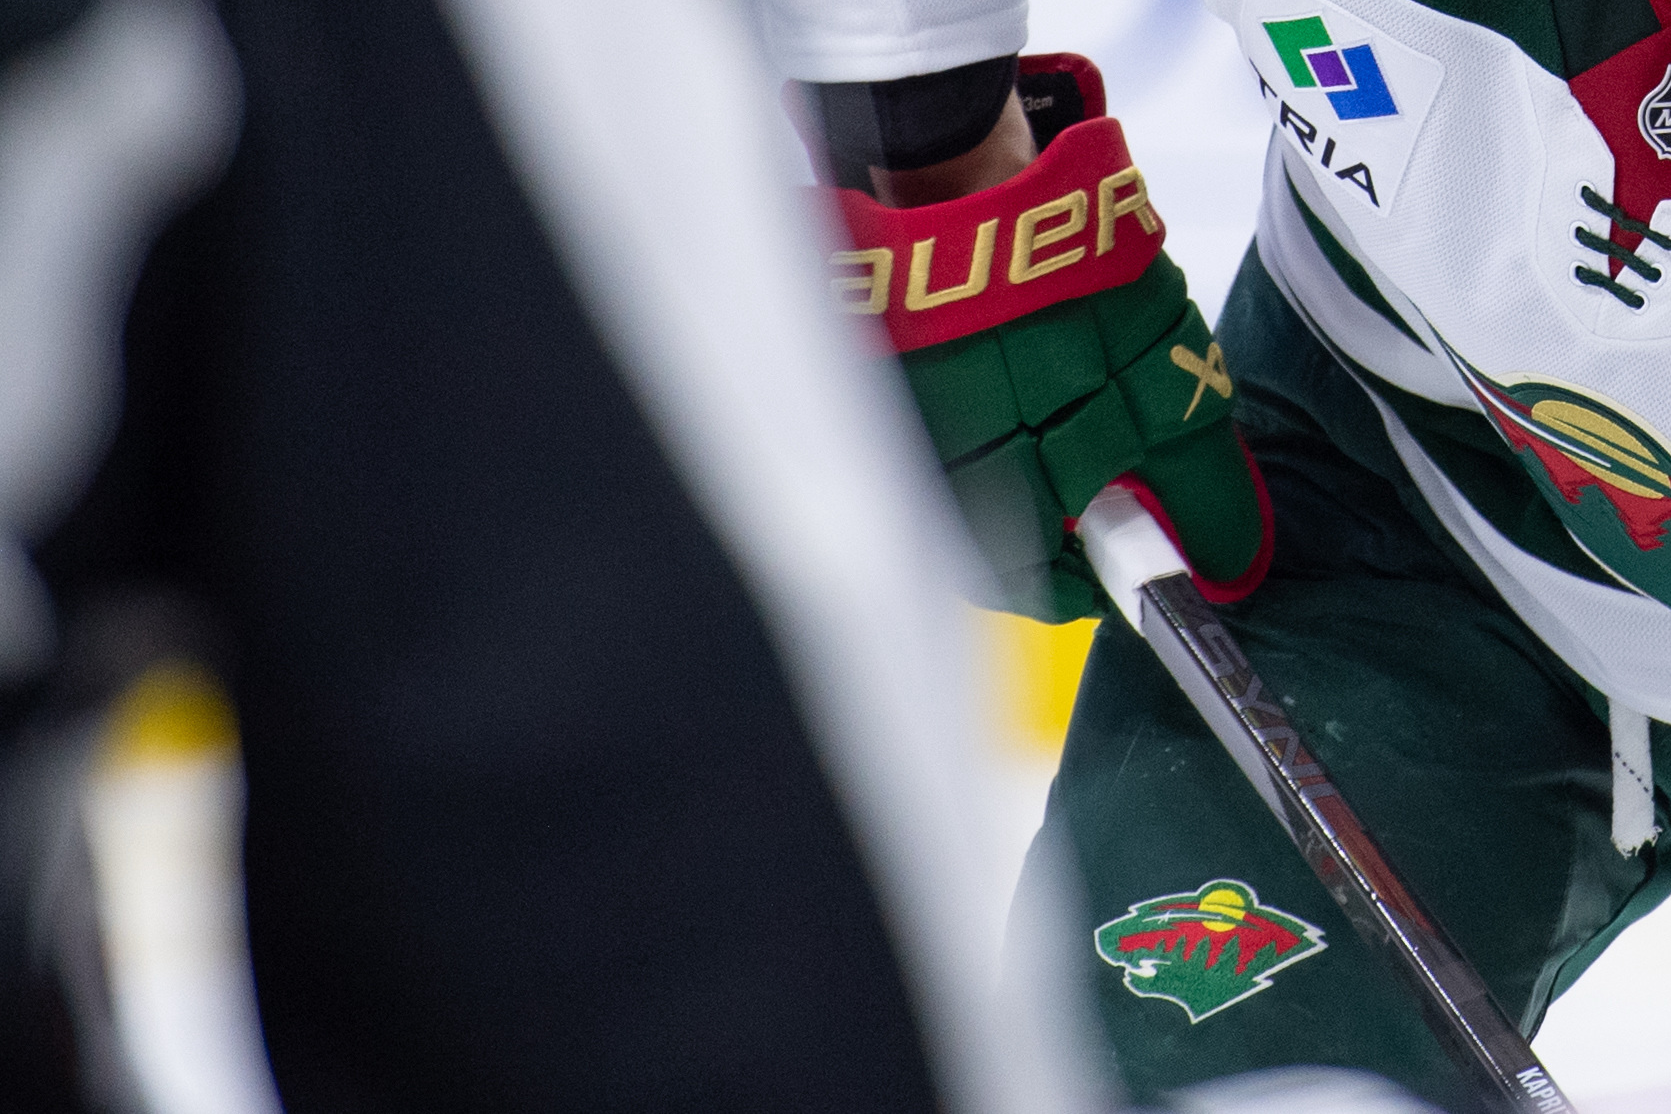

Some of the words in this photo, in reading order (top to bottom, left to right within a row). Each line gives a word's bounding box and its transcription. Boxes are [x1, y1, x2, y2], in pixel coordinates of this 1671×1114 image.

[1249, 57, 1381, 208] TRIA
[827, 165, 1160, 316] AUER
[1516, 1066, 1570, 1114] KAPRI
